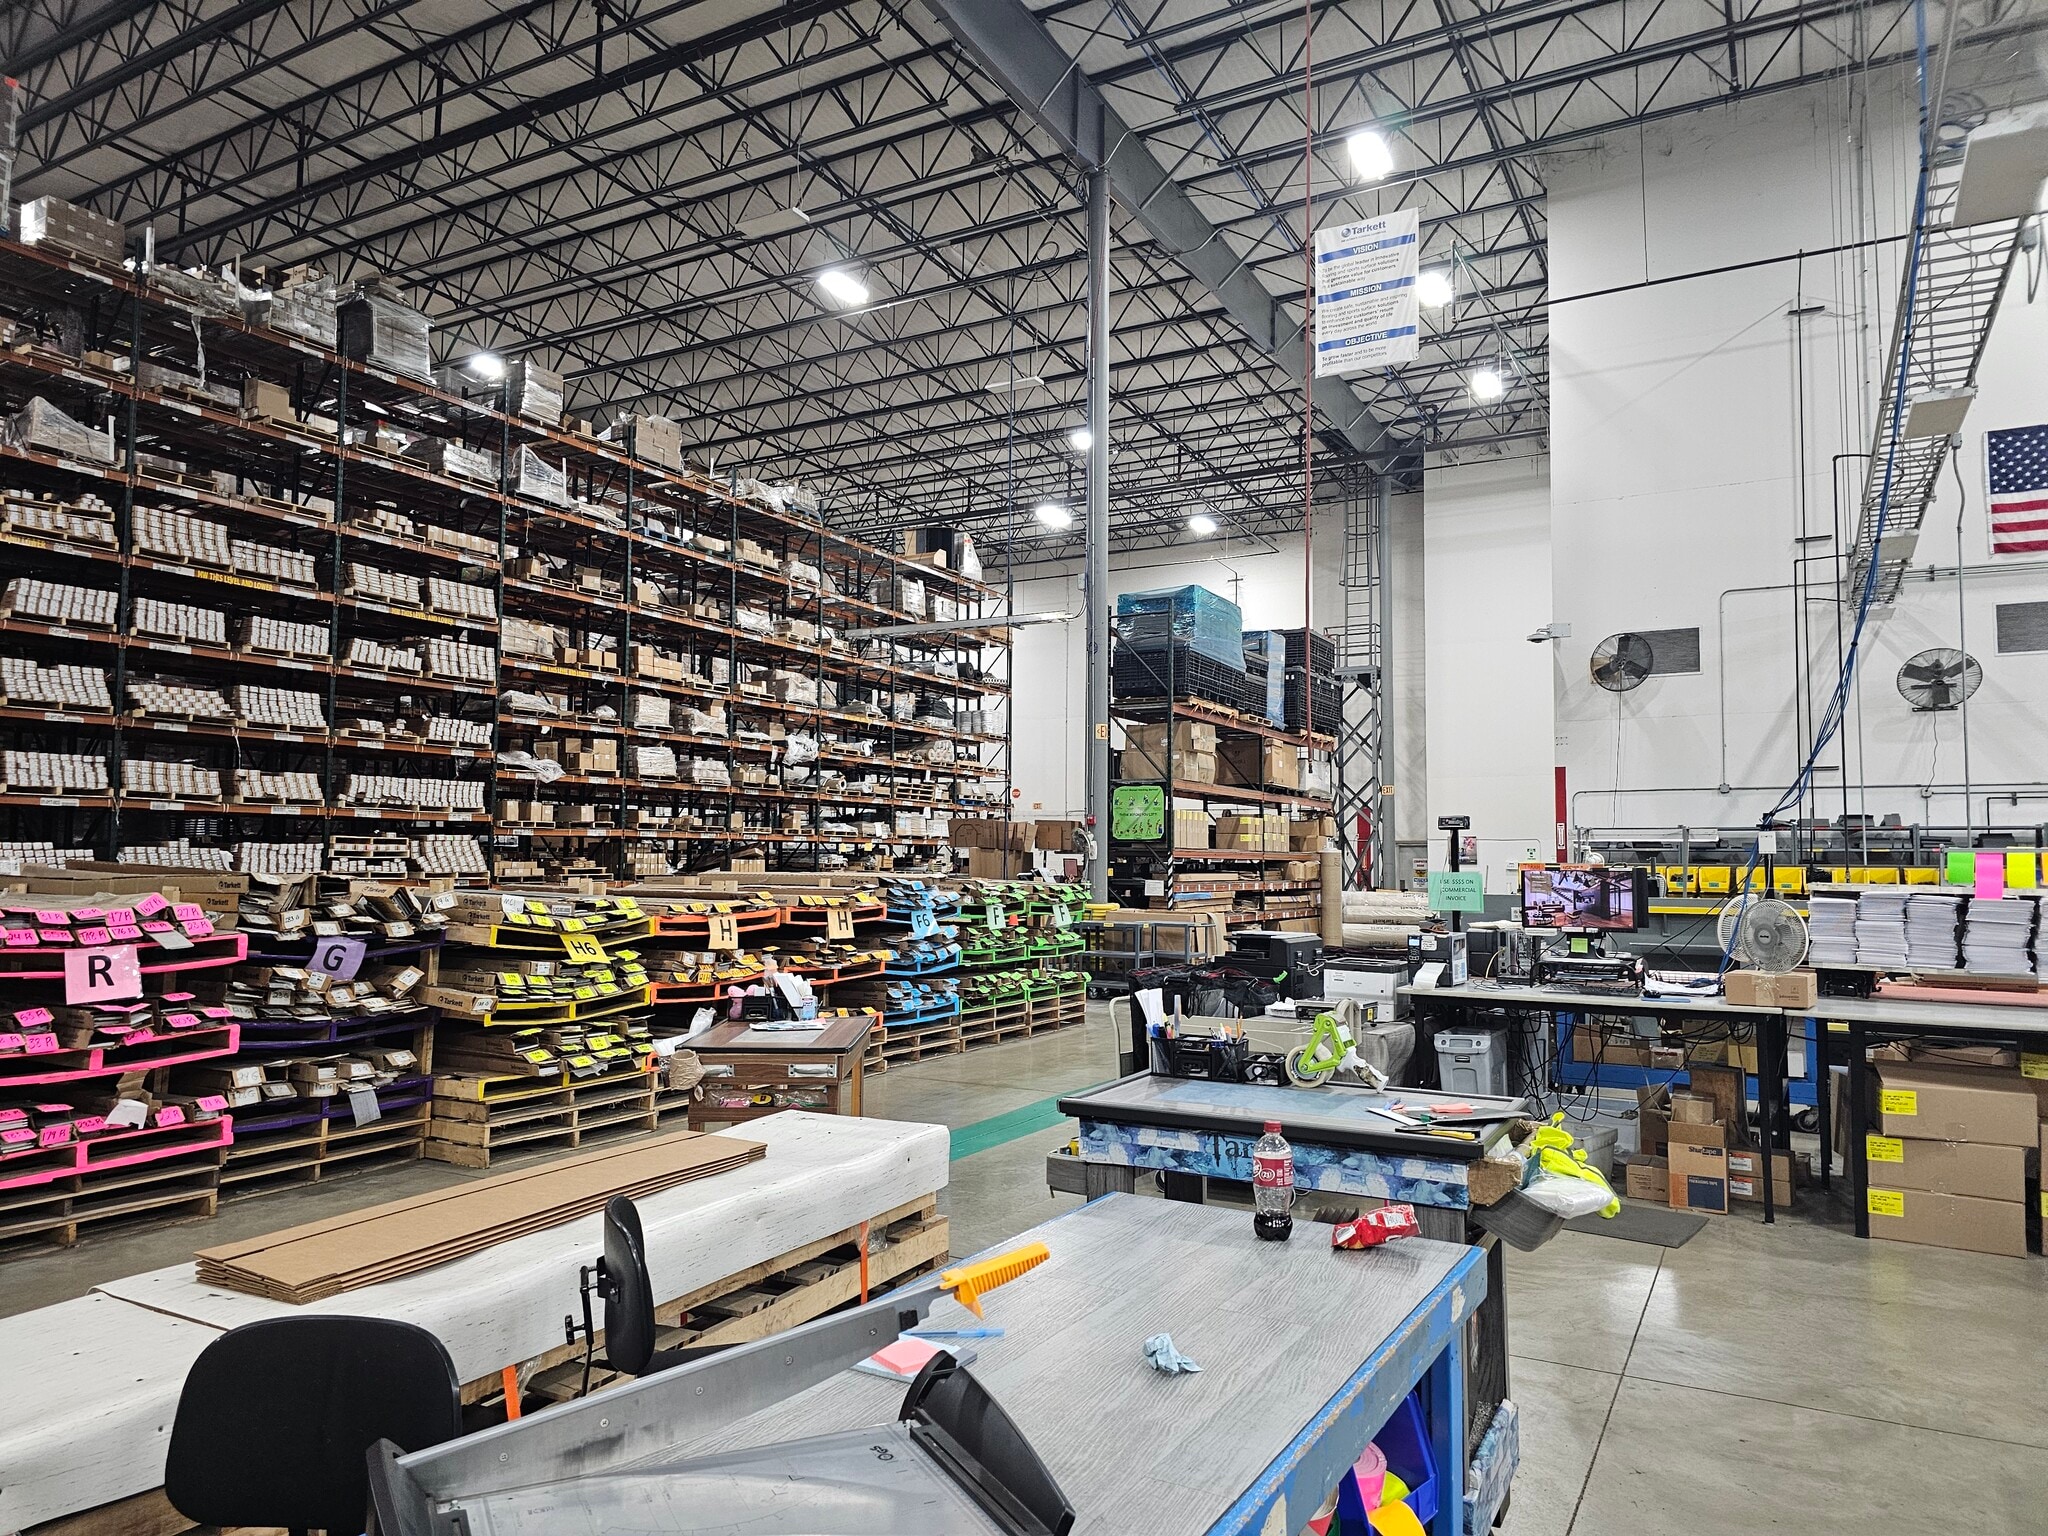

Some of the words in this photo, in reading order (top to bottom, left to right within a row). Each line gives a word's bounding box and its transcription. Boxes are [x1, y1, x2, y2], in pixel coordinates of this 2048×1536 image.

[1352, 221, 1386, 235] Tarkett
[1353, 243, 1379, 254] VISION
[1377, 258, 1399, 266] solutions
[1331, 275, 1350, 283] generate
[1331, 278, 1355, 287] sustainable
[1350, 285, 1382, 296] MISSION
[1345, 332, 1388, 345] OBJECTIVE
[209, 572, 223, 582] THIS
[224, 575, 241, 585] LEVEL
[241, 578, 254, 588] AND
[1382, 786, 1393, 794] EXIT
[368, 886, 387, 894] Tarkett
[994, 907, 1000, 924] F
[1058, 905, 1066, 922] F
[837, 911, 849, 931] H
[916, 913, 931, 929] F6
[720, 919, 733, 941] H
[570, 940, 597, 955] H6
[323, 945, 347, 971] G
[88, 954, 114, 988] R
[468, 974, 485, 982] Tarkett
[444, 997, 463, 1007] Tarkett
[1206, 1131, 1255, 1167] Tar
[1689, 1145, 1717, 1156] Shurtape
